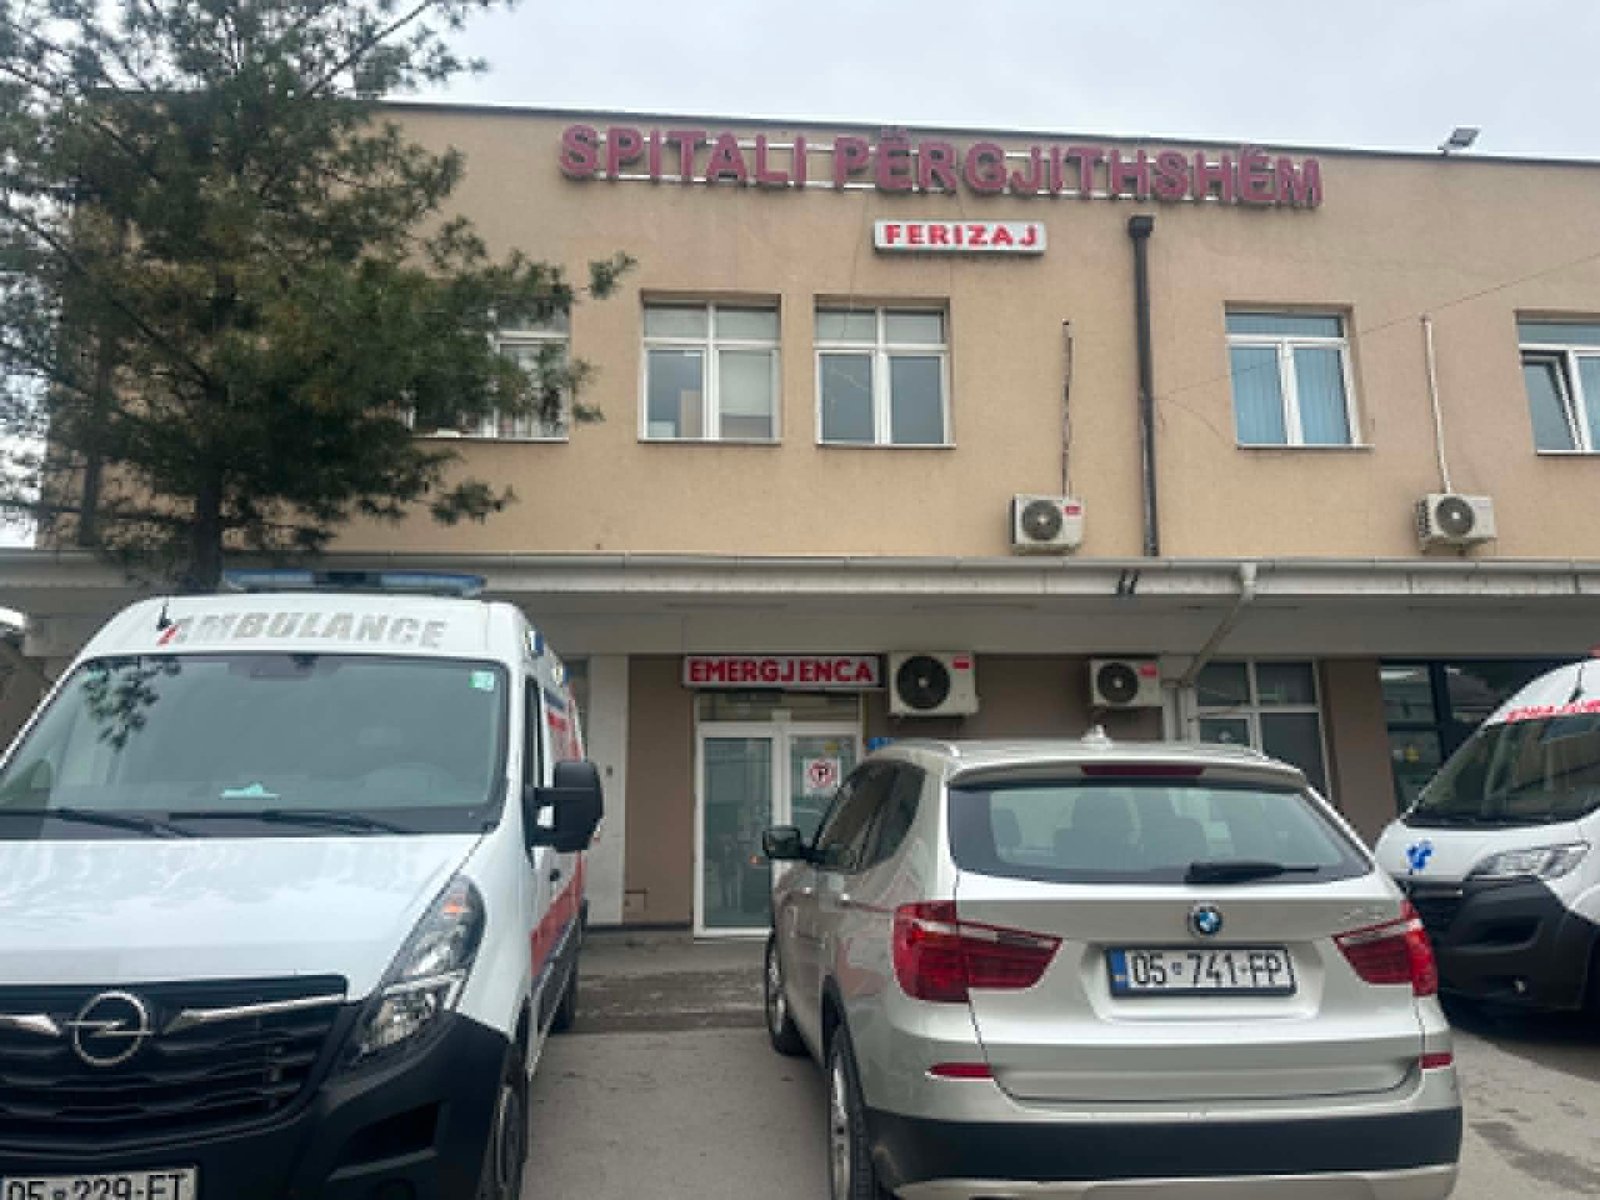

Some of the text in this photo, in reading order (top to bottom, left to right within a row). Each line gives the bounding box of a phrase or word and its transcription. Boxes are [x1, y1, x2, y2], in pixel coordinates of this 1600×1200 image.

[559, 124, 1323, 208] SPITALI PËRGJITHSHËM
[884, 223, 1037, 247] FERIZAJ
[156, 611, 448, 649] AMBULANCE
[688, 659, 873, 683] EMERGJENCA
